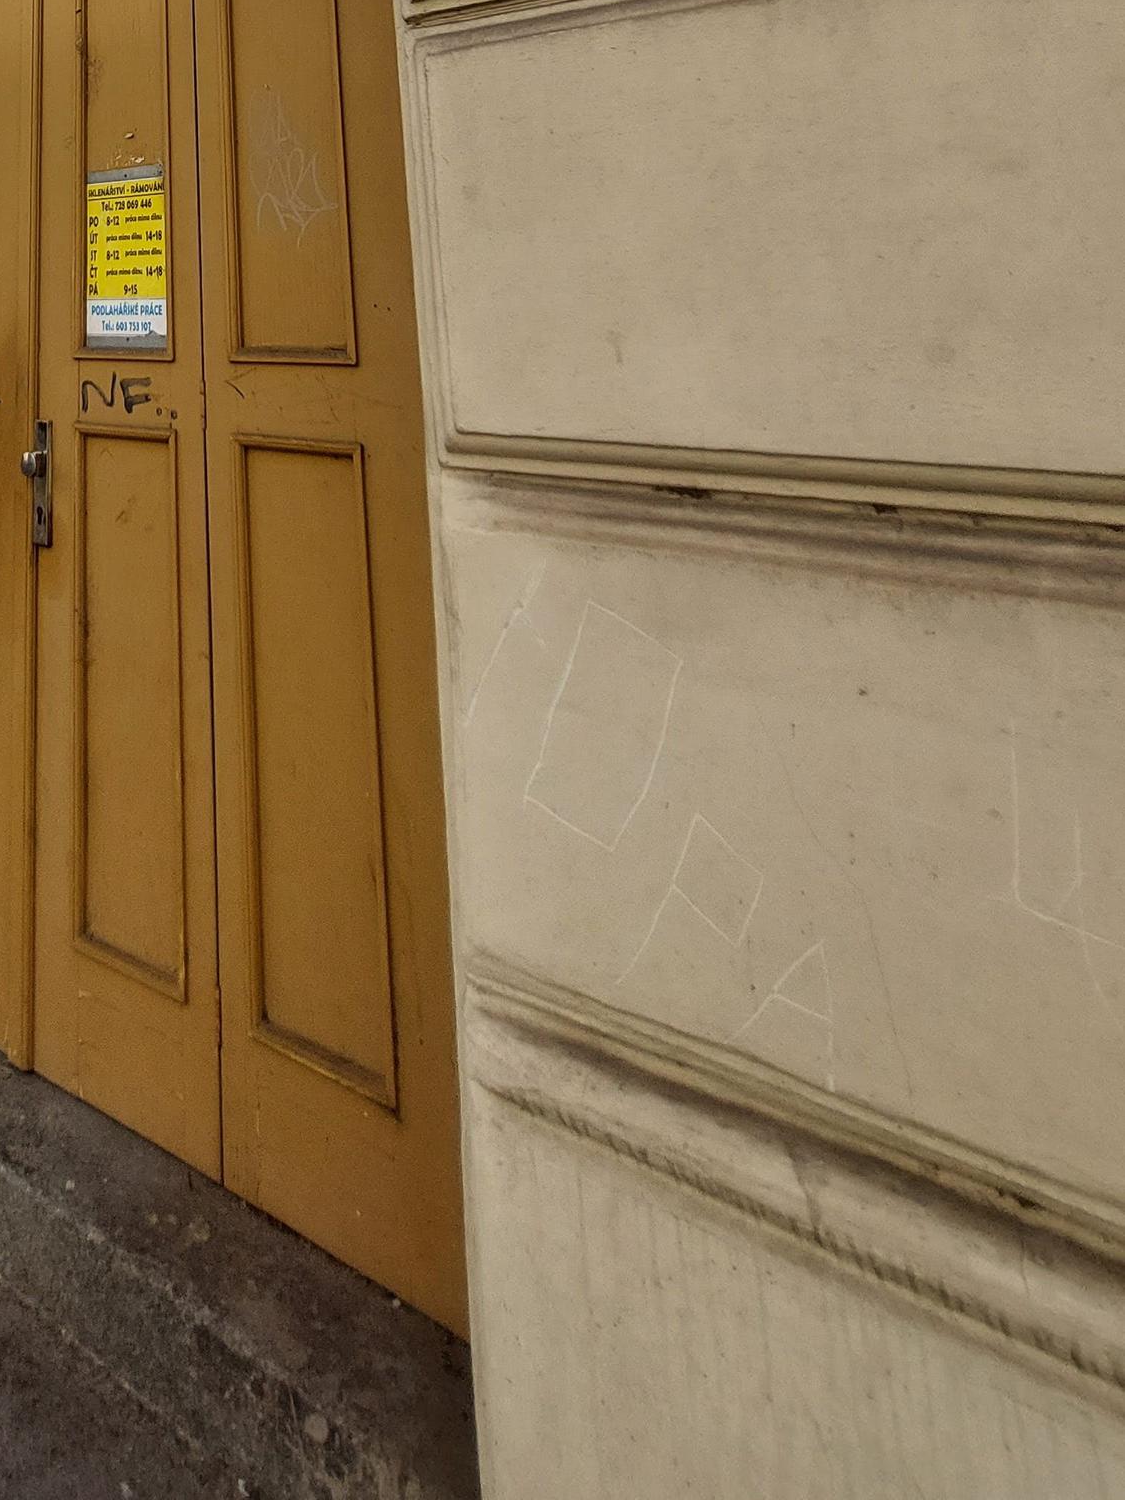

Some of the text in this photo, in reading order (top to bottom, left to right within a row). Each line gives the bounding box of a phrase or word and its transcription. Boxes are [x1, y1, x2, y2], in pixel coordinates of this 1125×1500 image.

[140, 198, 152, 208] 446
[89, 216, 99, 227] PO
[90, 229, 98, 245] ÚT
[90, 264, 98, 278] ČT
[89, 282, 99, 296] PÁ
[140, 302, 163, 316] PRÁCE
